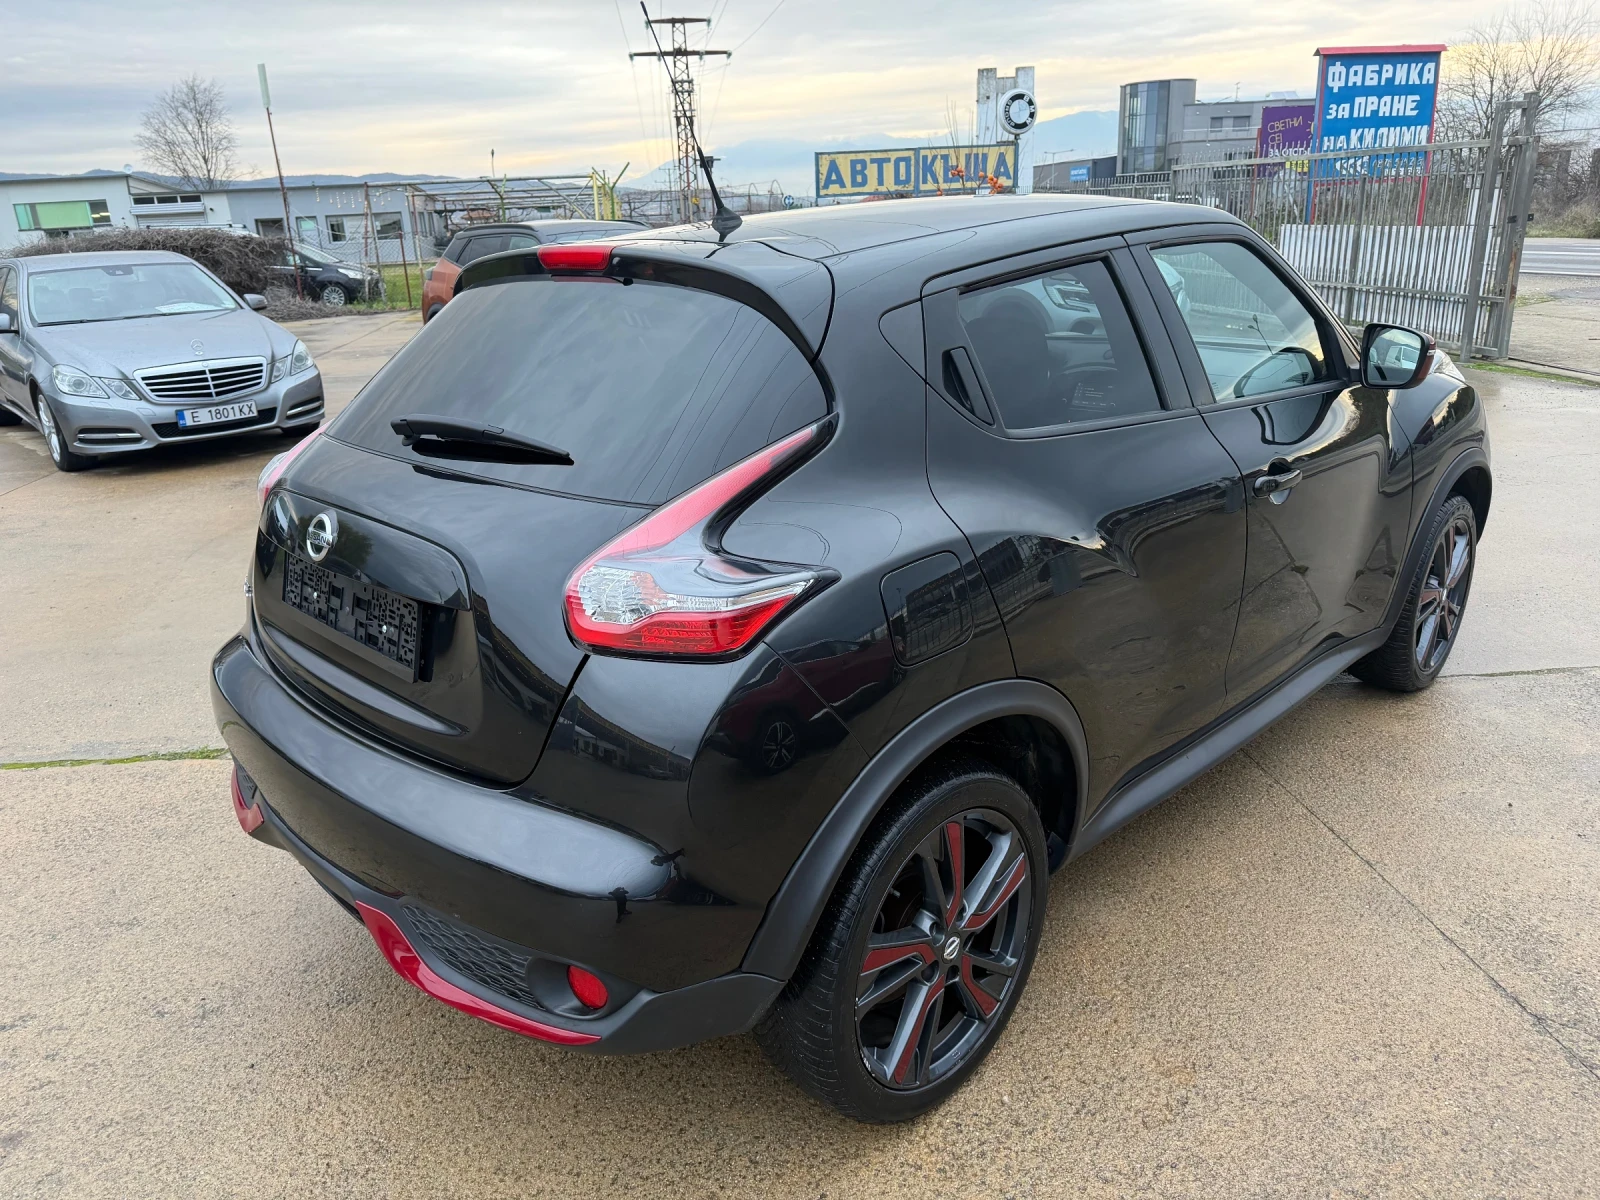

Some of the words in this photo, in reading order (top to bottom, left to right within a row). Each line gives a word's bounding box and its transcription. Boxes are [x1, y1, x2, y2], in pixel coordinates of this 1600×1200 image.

[1327, 61, 1436, 93] ФАБРИКА
[1353, 94, 1420, 118] ПРАНЕ
[1267, 116, 1303, 132] СВЕТНИ
[1323, 135, 1348, 151] НА
[1349, 124, 1429, 150] КИЛИМИ
[191, 410, 201, 423] E
[308, 530, 329, 546] SAN
